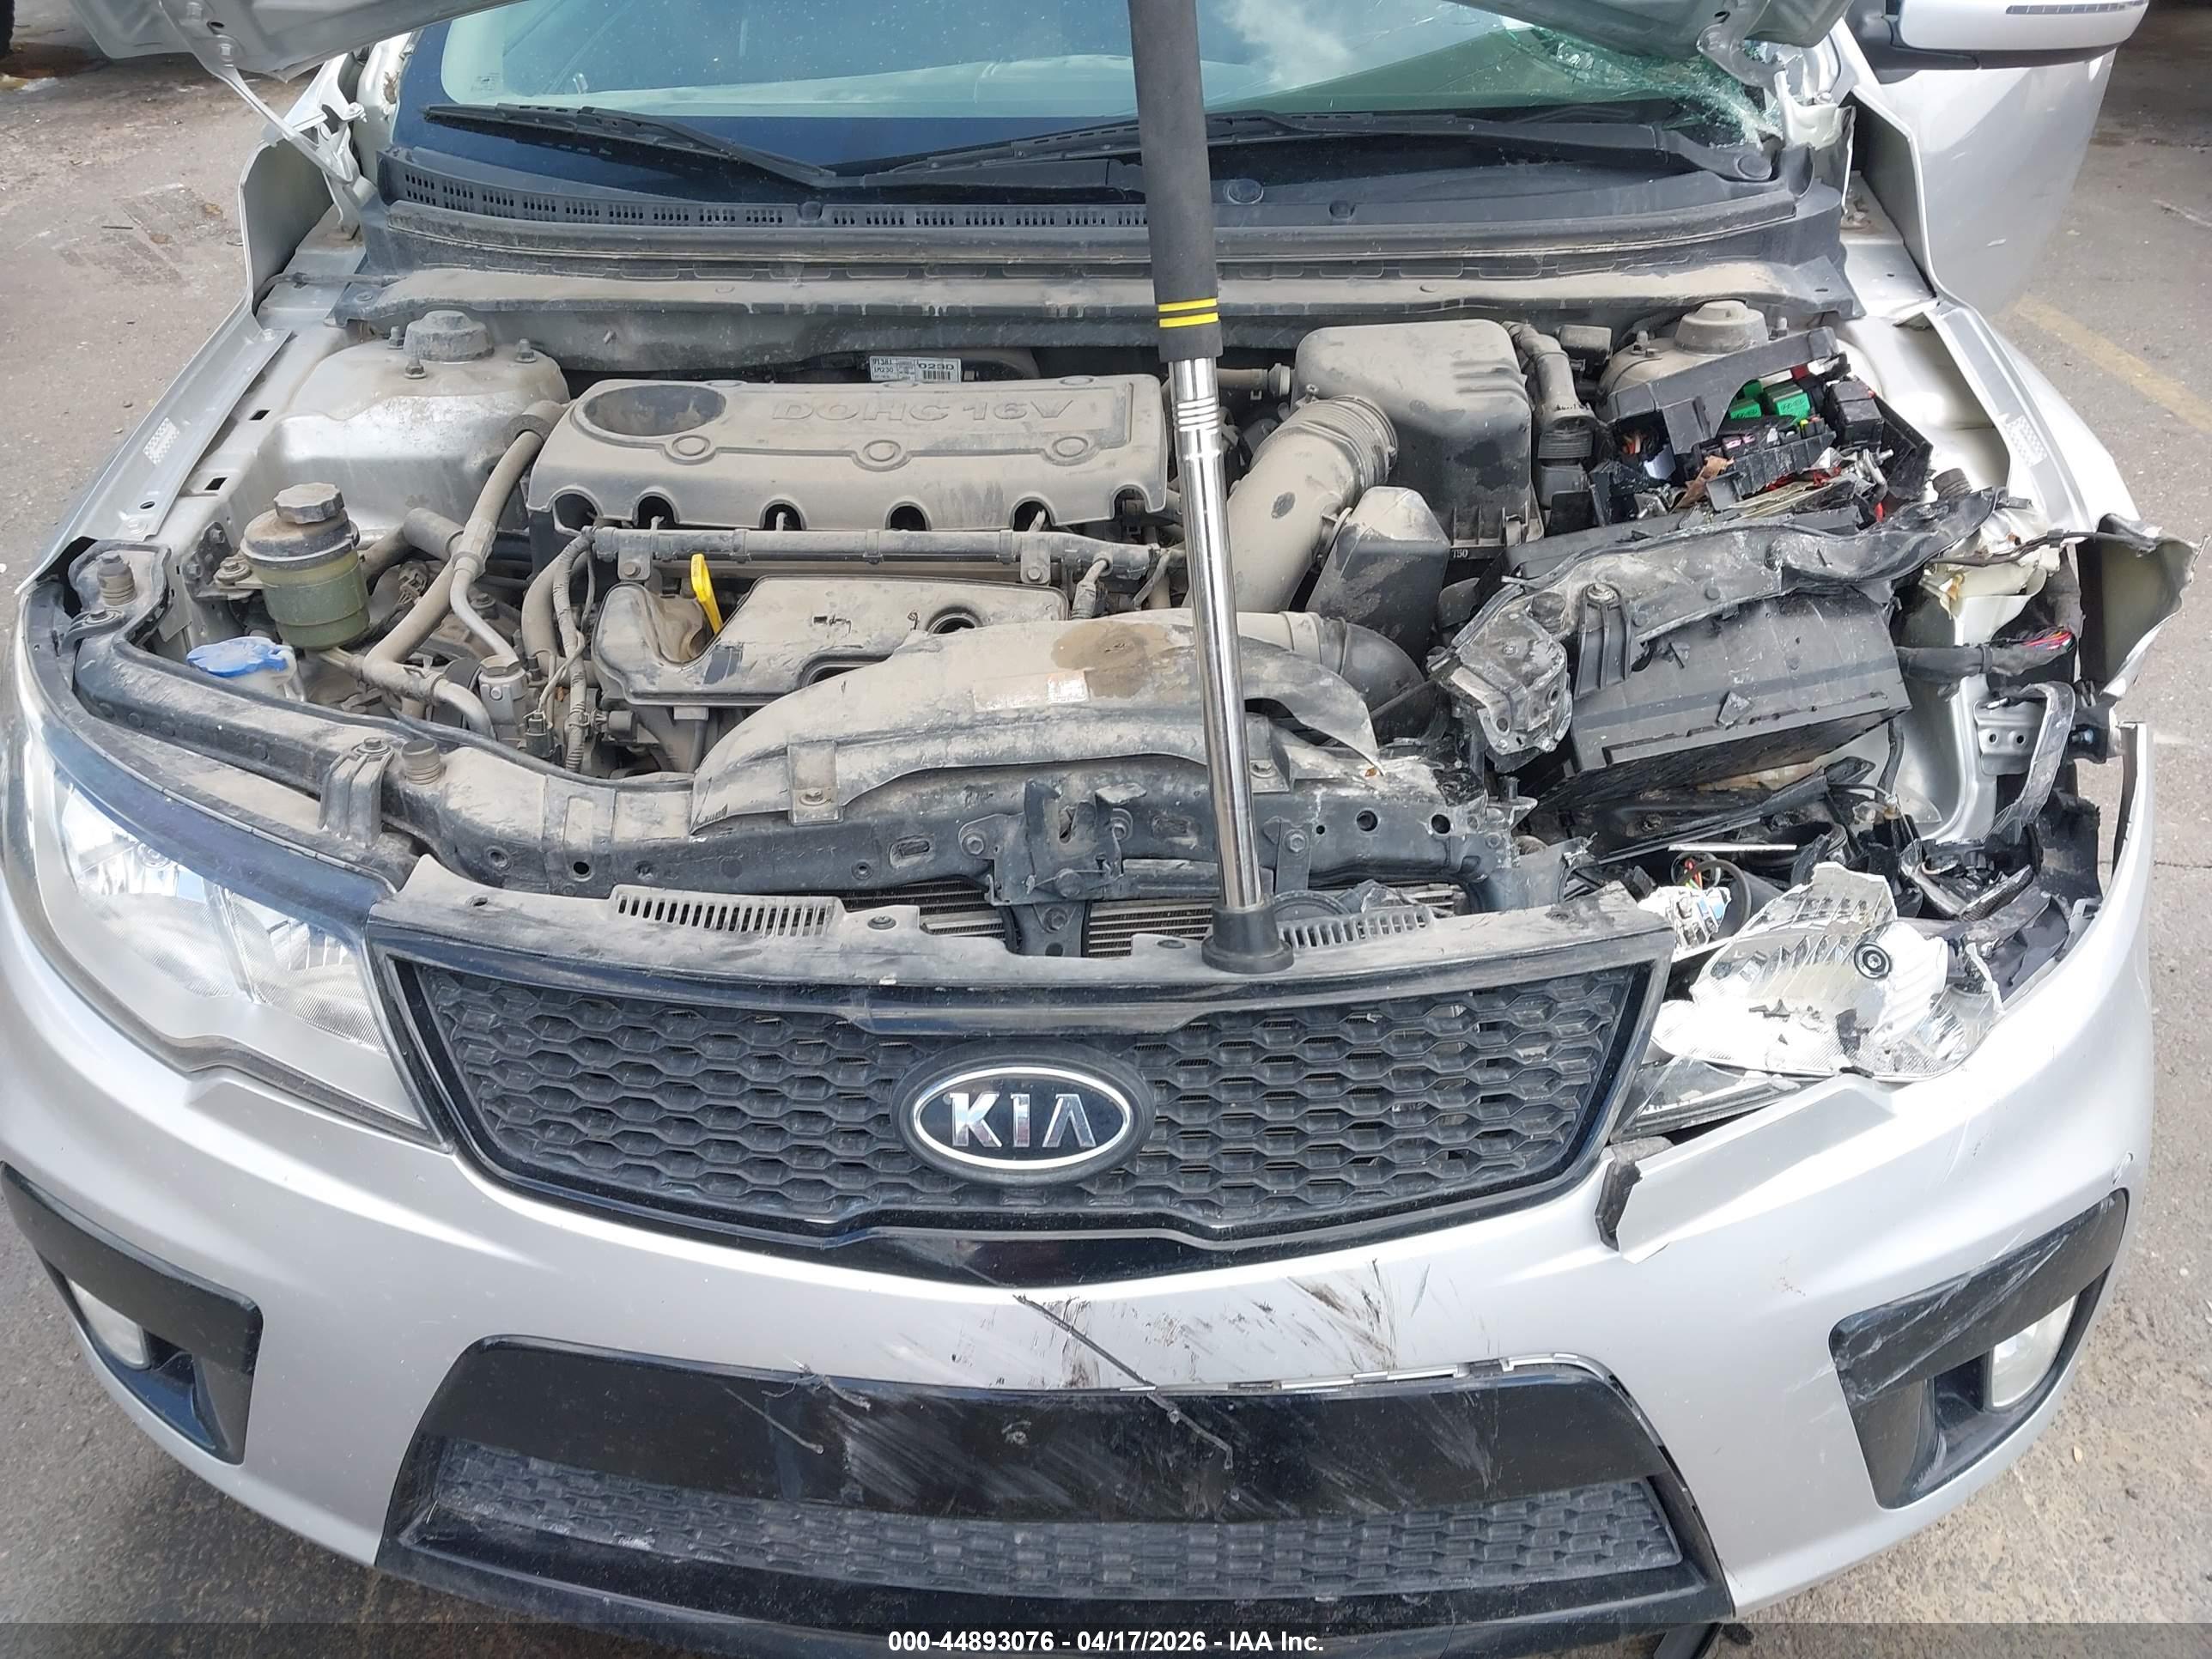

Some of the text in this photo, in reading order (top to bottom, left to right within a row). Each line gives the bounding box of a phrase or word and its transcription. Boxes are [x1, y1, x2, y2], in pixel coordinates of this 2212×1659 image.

[772, 399, 1073, 422] DOHC 16V
[949, 1091, 1097, 1148] KIA
